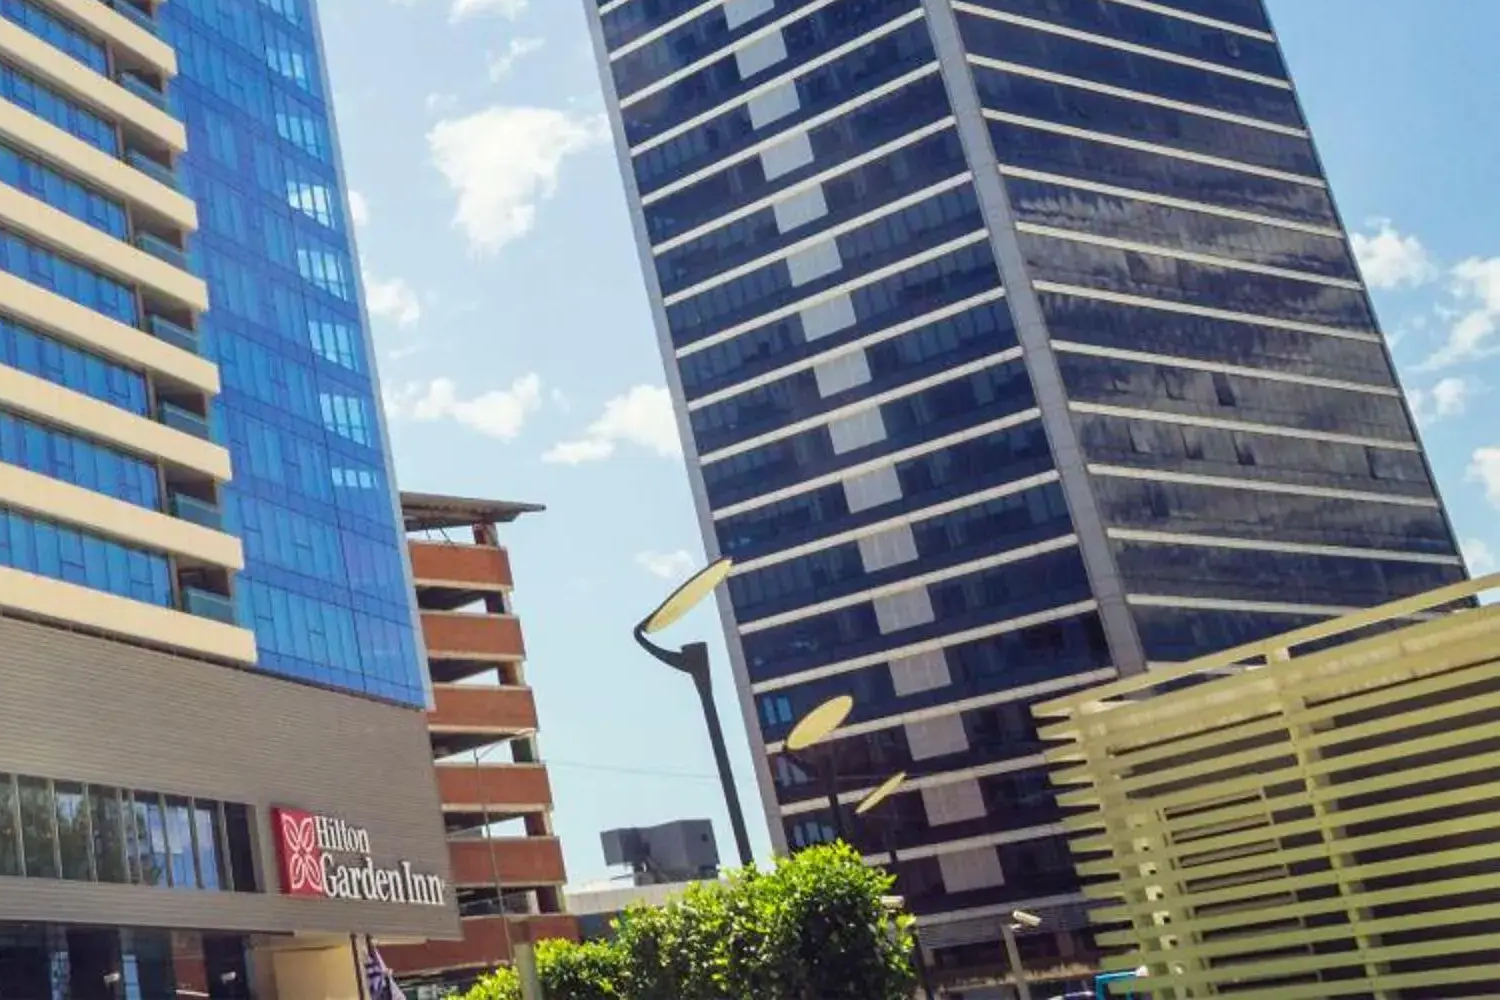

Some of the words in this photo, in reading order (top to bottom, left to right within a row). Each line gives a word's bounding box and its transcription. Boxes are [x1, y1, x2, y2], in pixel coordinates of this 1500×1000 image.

[315, 815, 370, 852] Hilton
[321, 851, 405, 903] Garden
[402, 860, 445, 905] Inn
